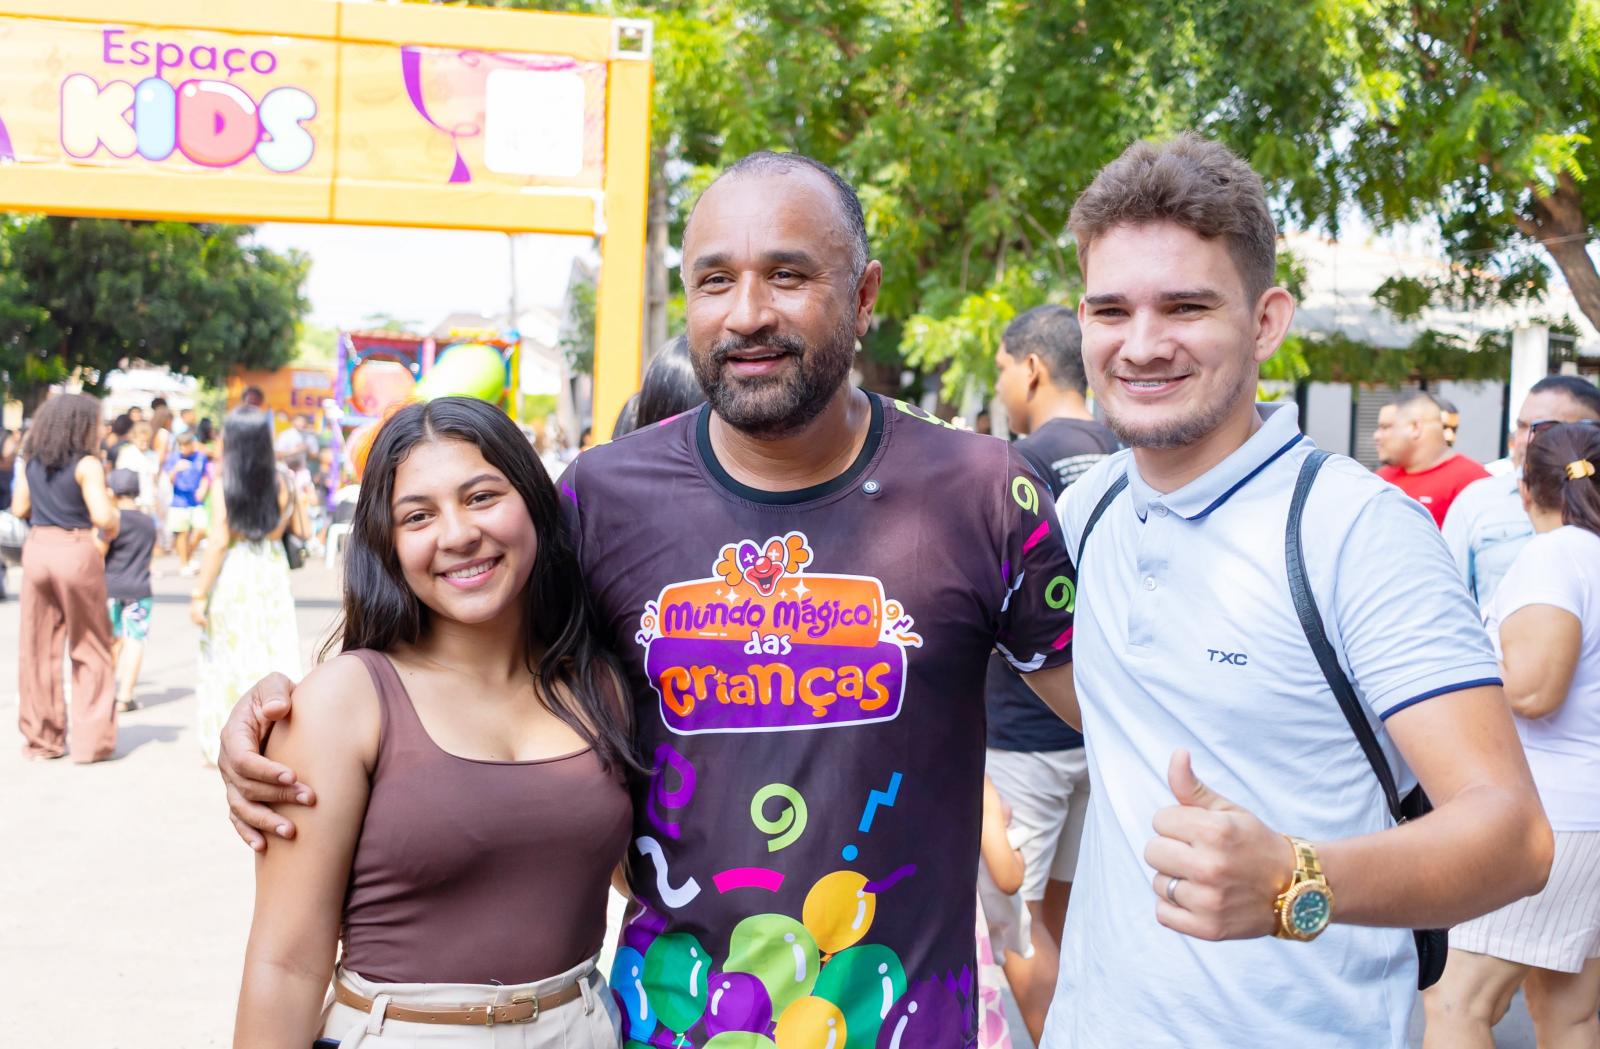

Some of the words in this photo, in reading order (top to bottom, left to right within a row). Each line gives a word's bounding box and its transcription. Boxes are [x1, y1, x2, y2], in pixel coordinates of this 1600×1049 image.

[103, 29, 277, 78] Espaço
[60, 73, 318, 173] KIDS
[743, 630, 793, 655] das
[1207, 648, 1248, 666] TXC
